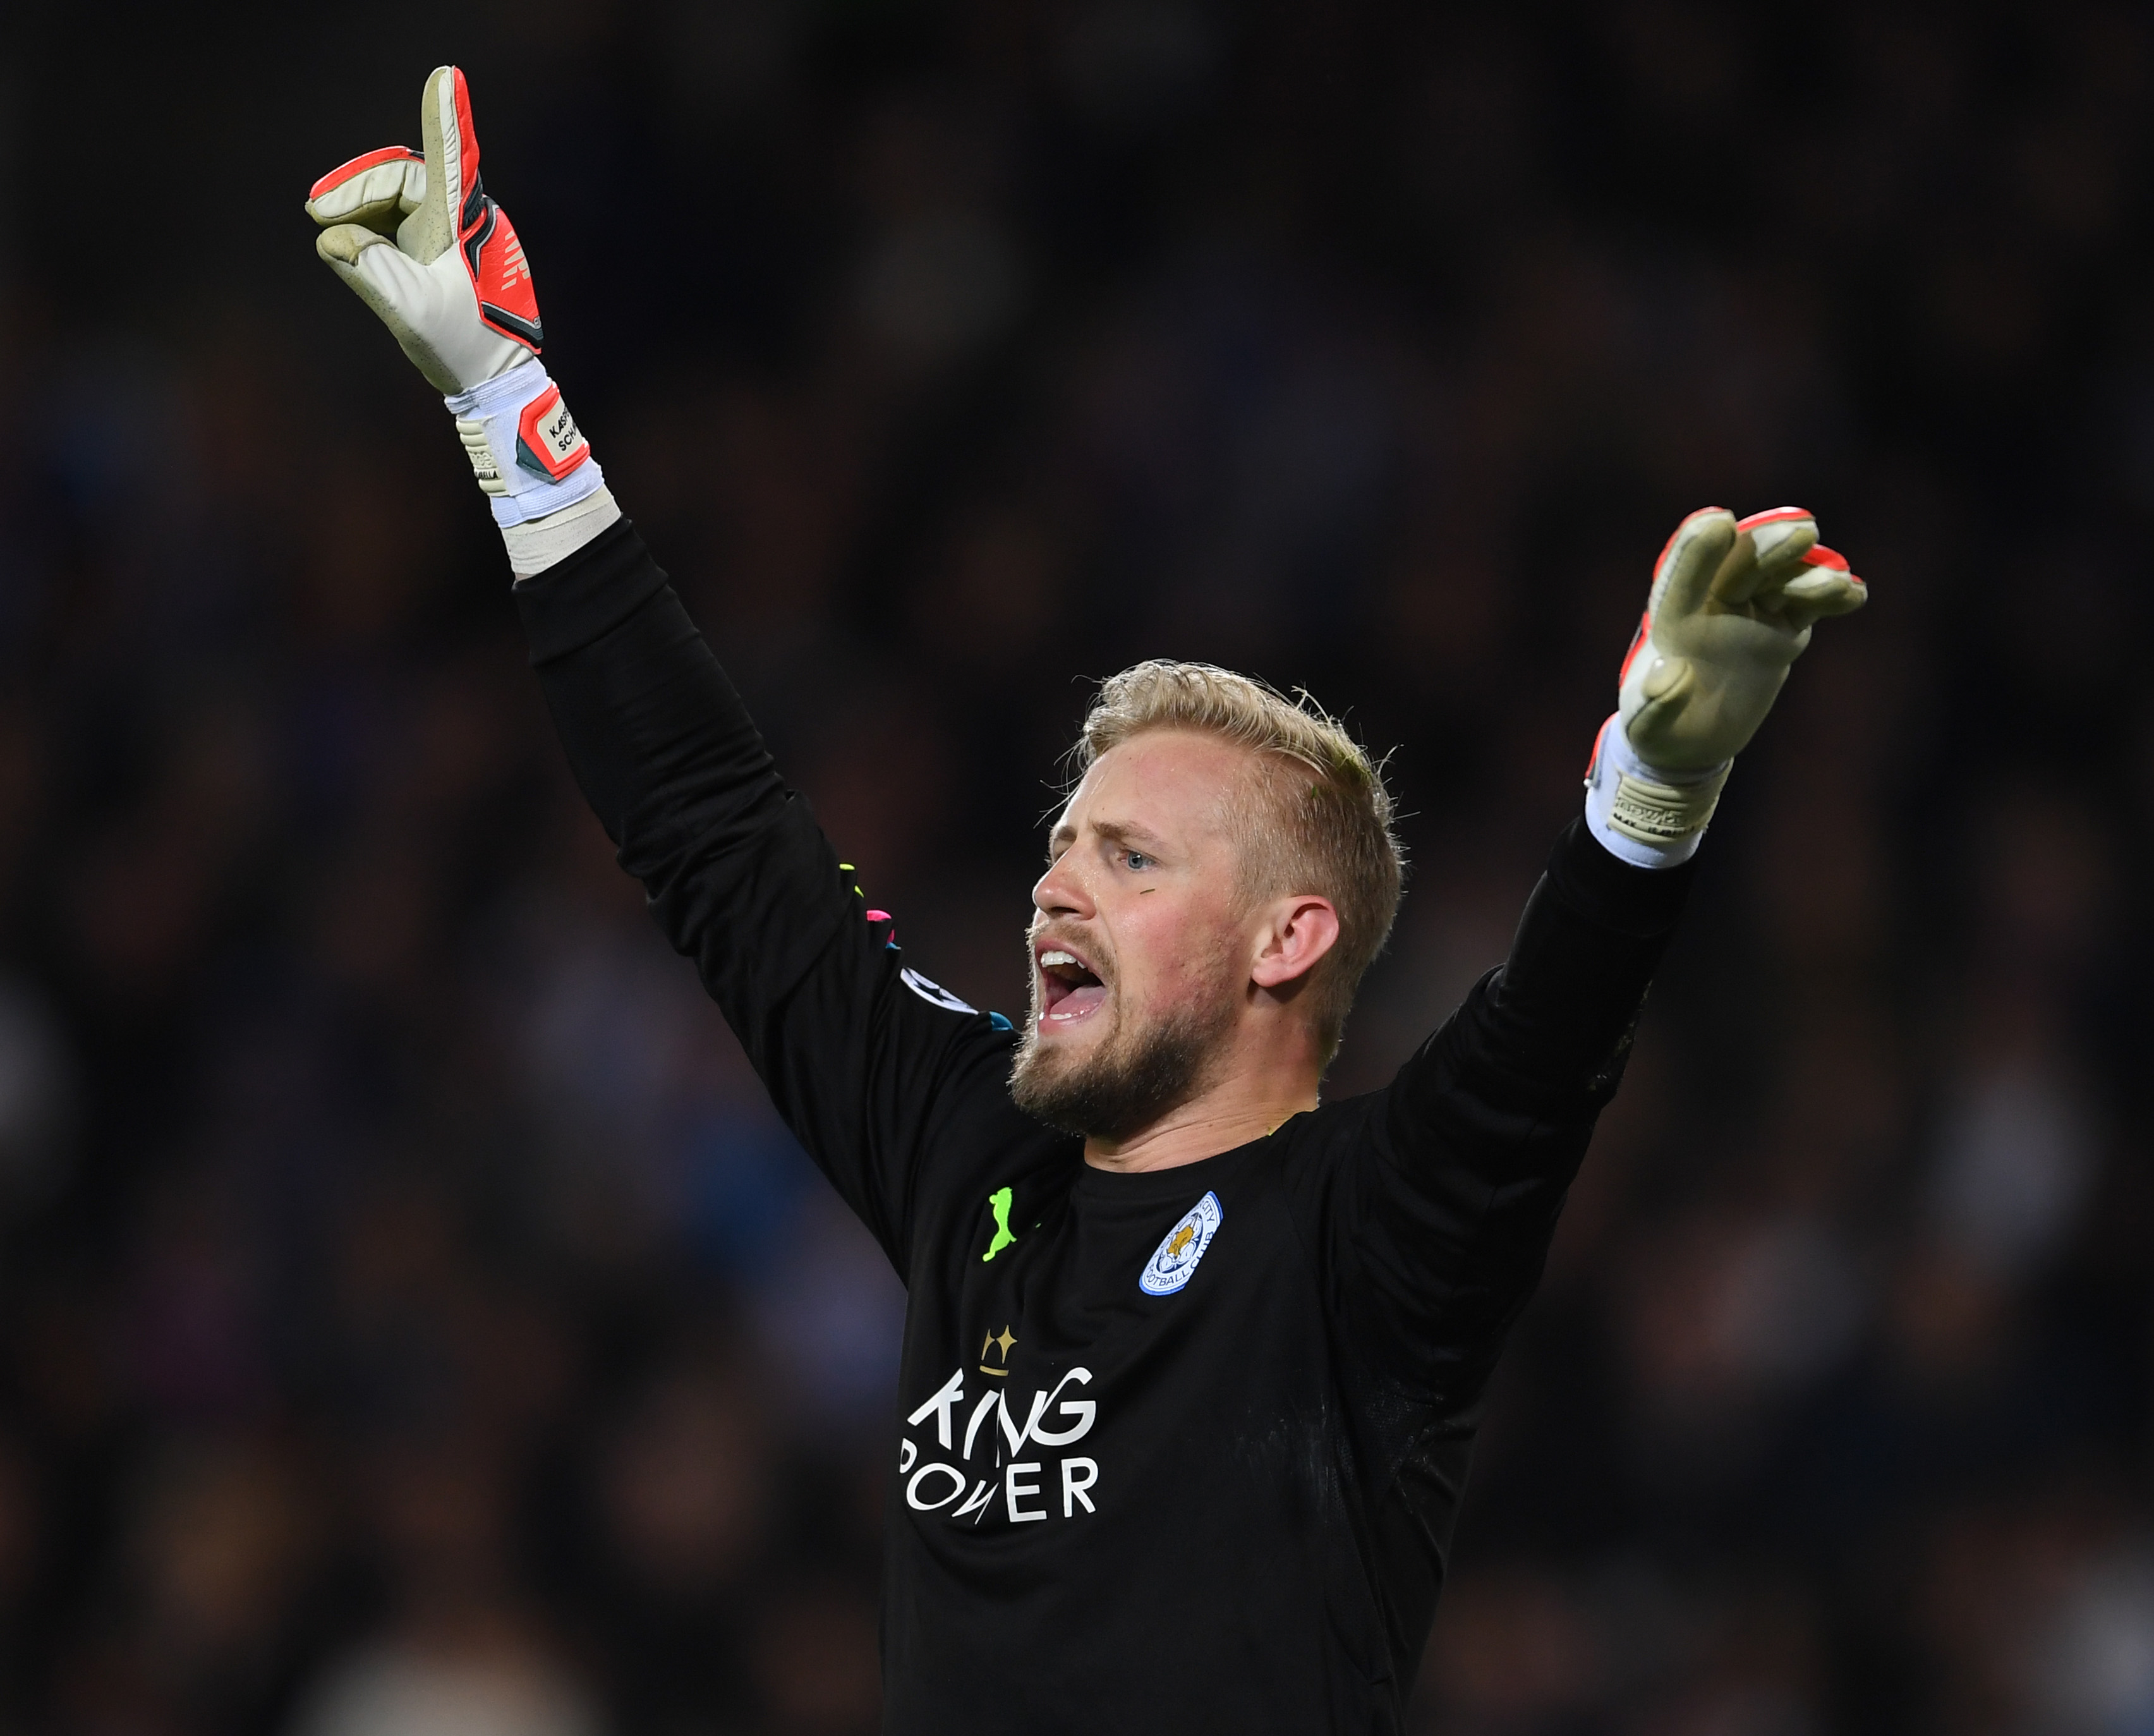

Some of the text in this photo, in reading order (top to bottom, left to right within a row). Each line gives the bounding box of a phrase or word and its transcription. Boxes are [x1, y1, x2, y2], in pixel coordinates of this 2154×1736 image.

[1202, 1200, 1215, 1222] CITY
[907, 1366, 1097, 1469] KING
[899, 1438, 1099, 1525] POWER
